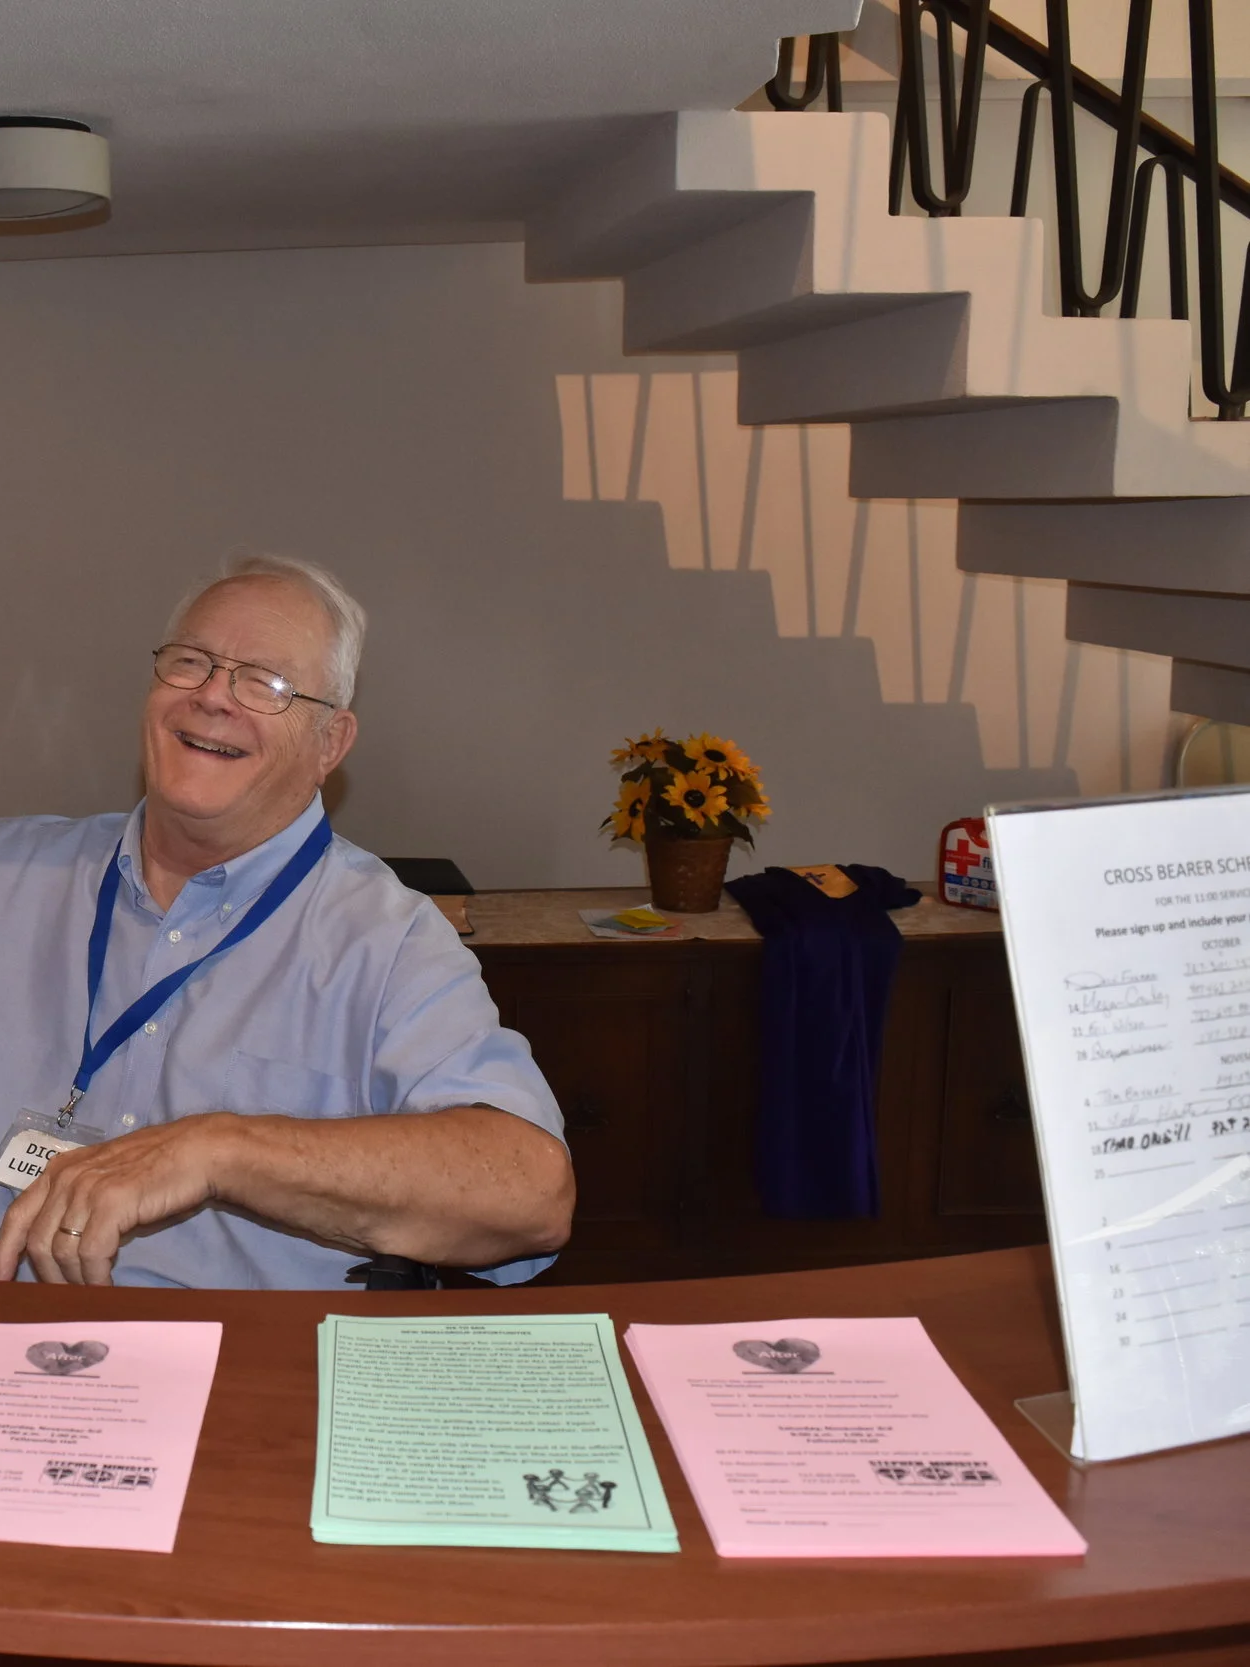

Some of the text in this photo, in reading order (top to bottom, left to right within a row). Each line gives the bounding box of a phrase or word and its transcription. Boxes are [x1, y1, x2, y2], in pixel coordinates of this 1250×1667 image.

[1104, 865, 1153, 886] CROSS
[1157, 860, 1215, 881] BEARER
[1155, 896, 1173, 907] FOR
[1175, 894, 1192, 905] THE
[1095, 914, 1246, 938] Please sign up and include your
[26, 1143, 61, 1161] DIC
